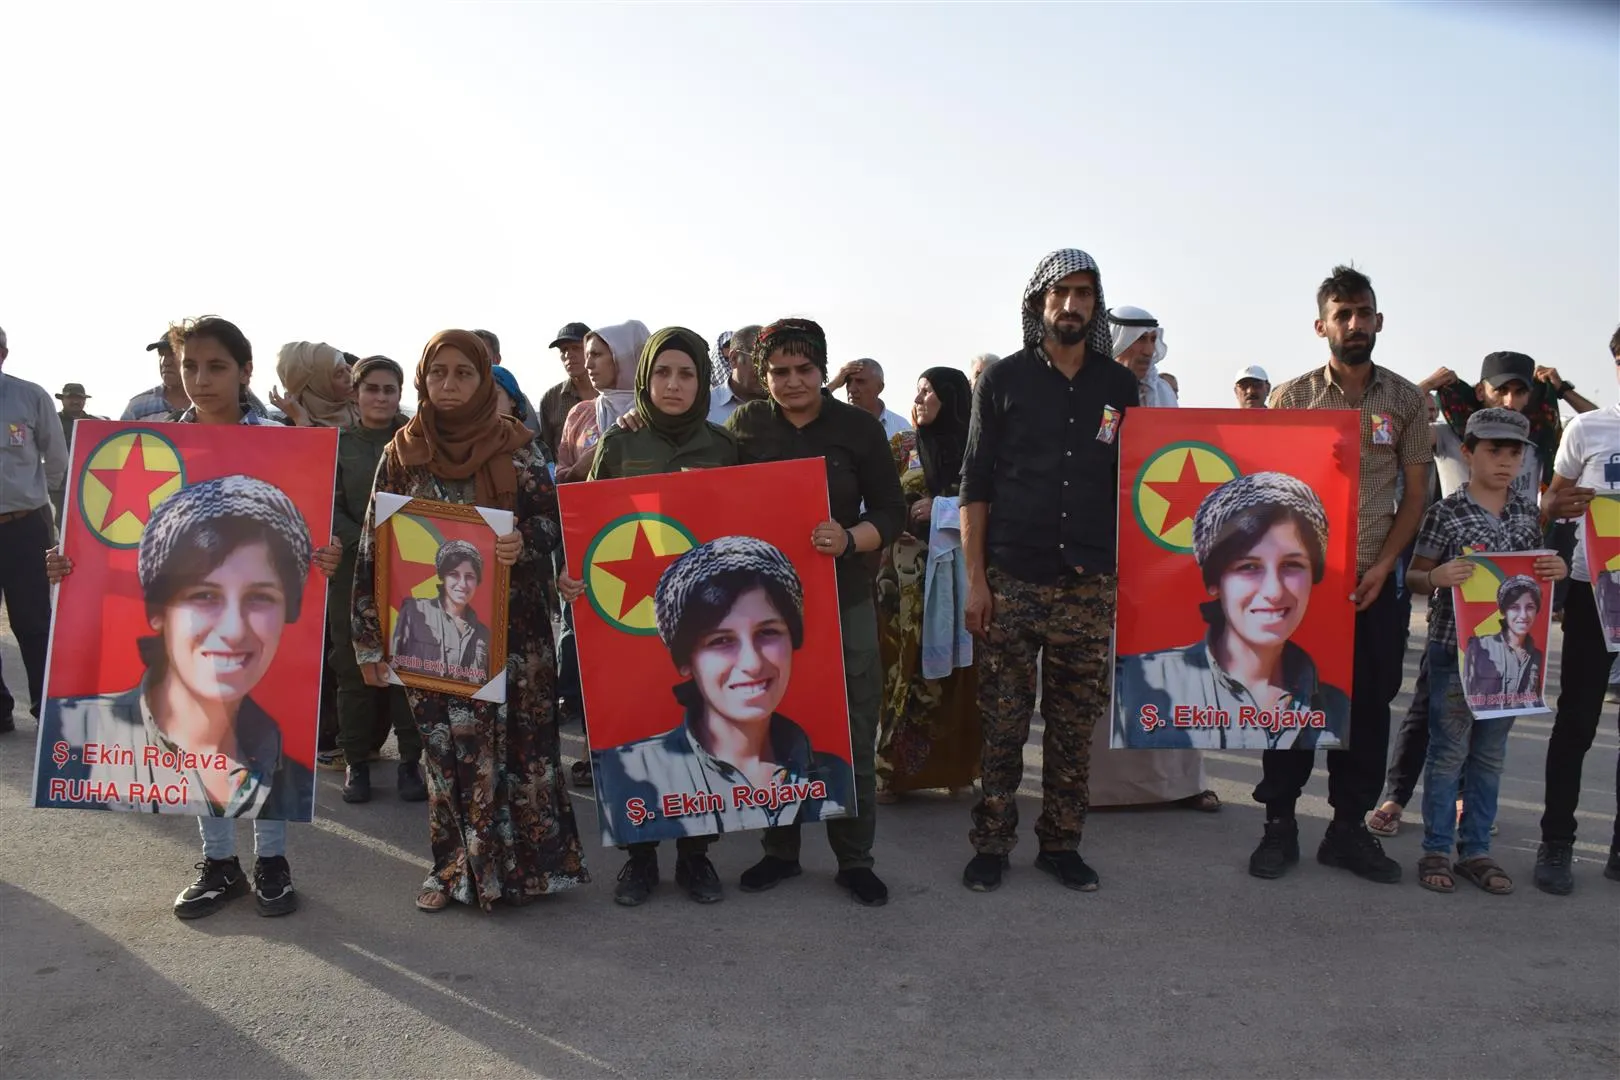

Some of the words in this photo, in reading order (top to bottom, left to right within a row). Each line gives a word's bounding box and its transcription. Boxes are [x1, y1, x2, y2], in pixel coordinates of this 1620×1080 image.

[1140, 704, 1165, 731] Ş.
[1173, 705, 1229, 727] Ekîn
[1238, 705, 1326, 733] Rojava
[52, 741, 78, 770] Ş.
[82, 742, 134, 767] Ekîn
[143, 745, 228, 773] Rojava
[50, 778, 120, 803] RUHA
[128, 777, 188, 805] RACÎ
[626, 797, 655, 825] Ş.
[662, 789, 724, 818] Ekîn
[732, 780, 827, 810] Rojava
